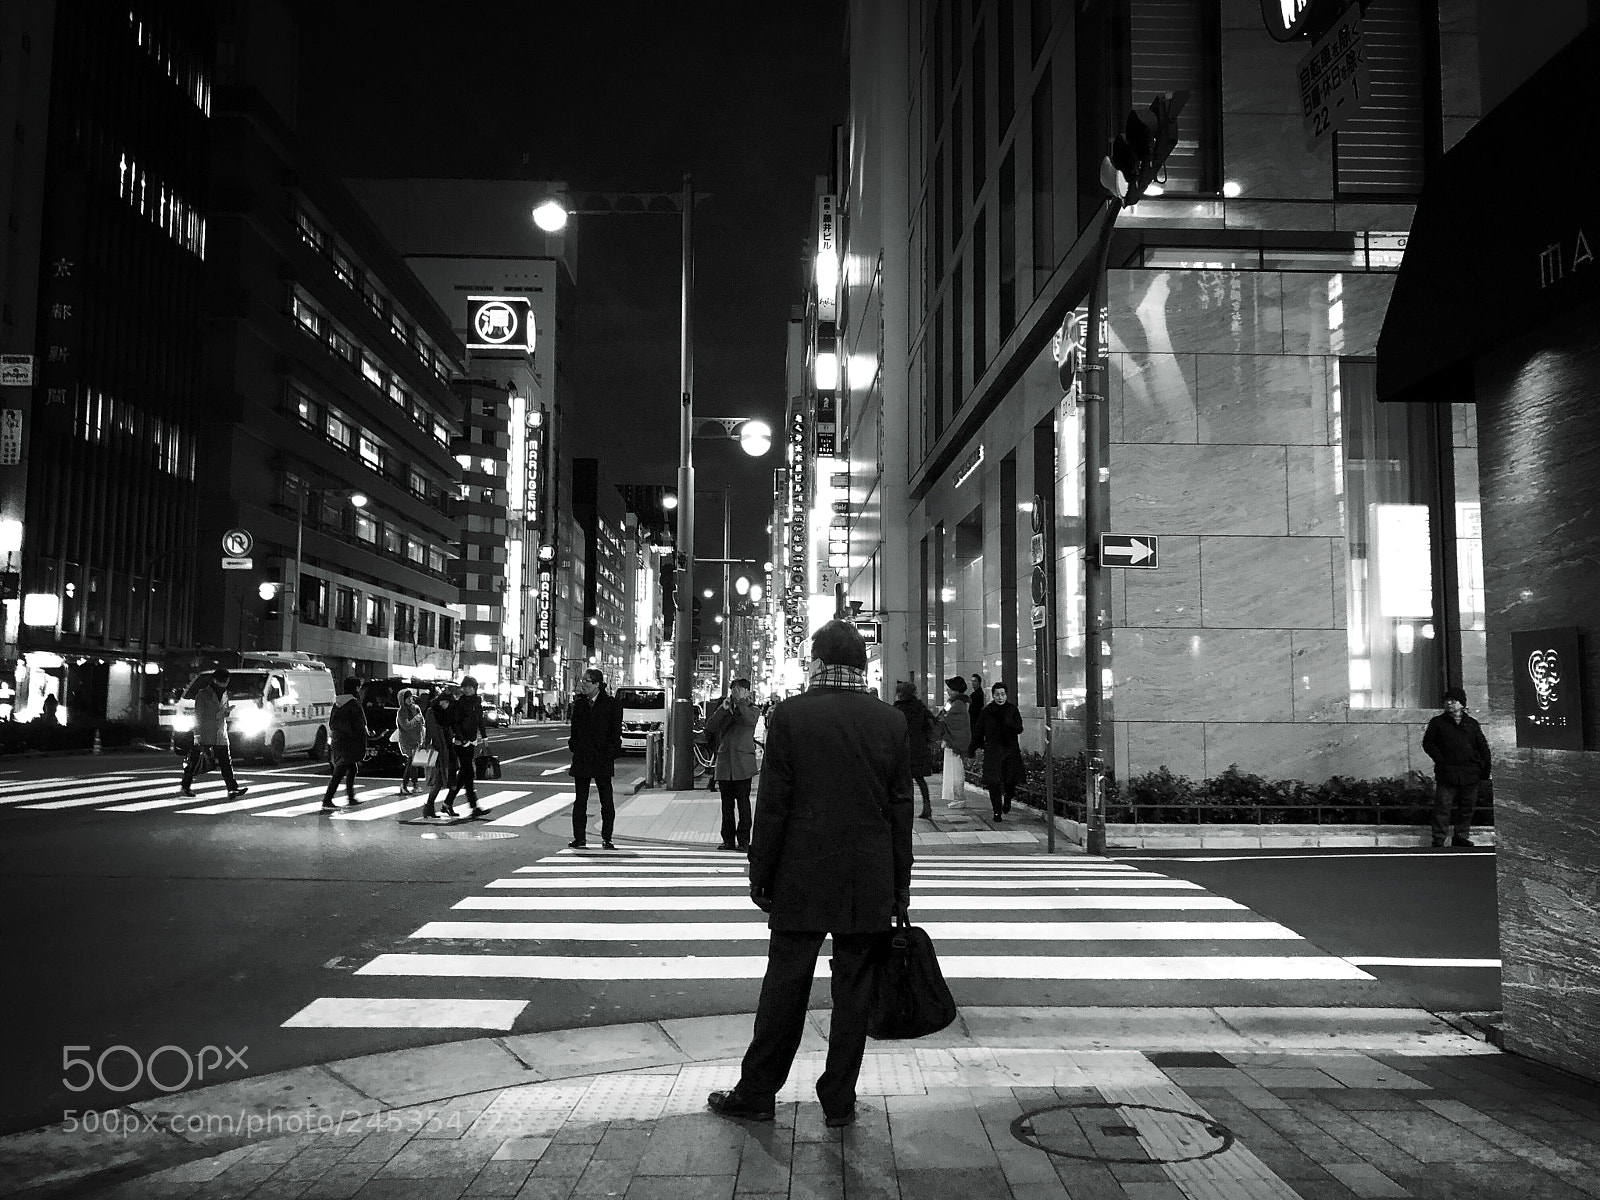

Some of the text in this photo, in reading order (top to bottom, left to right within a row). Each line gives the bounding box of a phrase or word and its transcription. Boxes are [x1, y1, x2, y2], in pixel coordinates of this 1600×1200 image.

[1300, 20, 1359, 91] 自転車を除く
